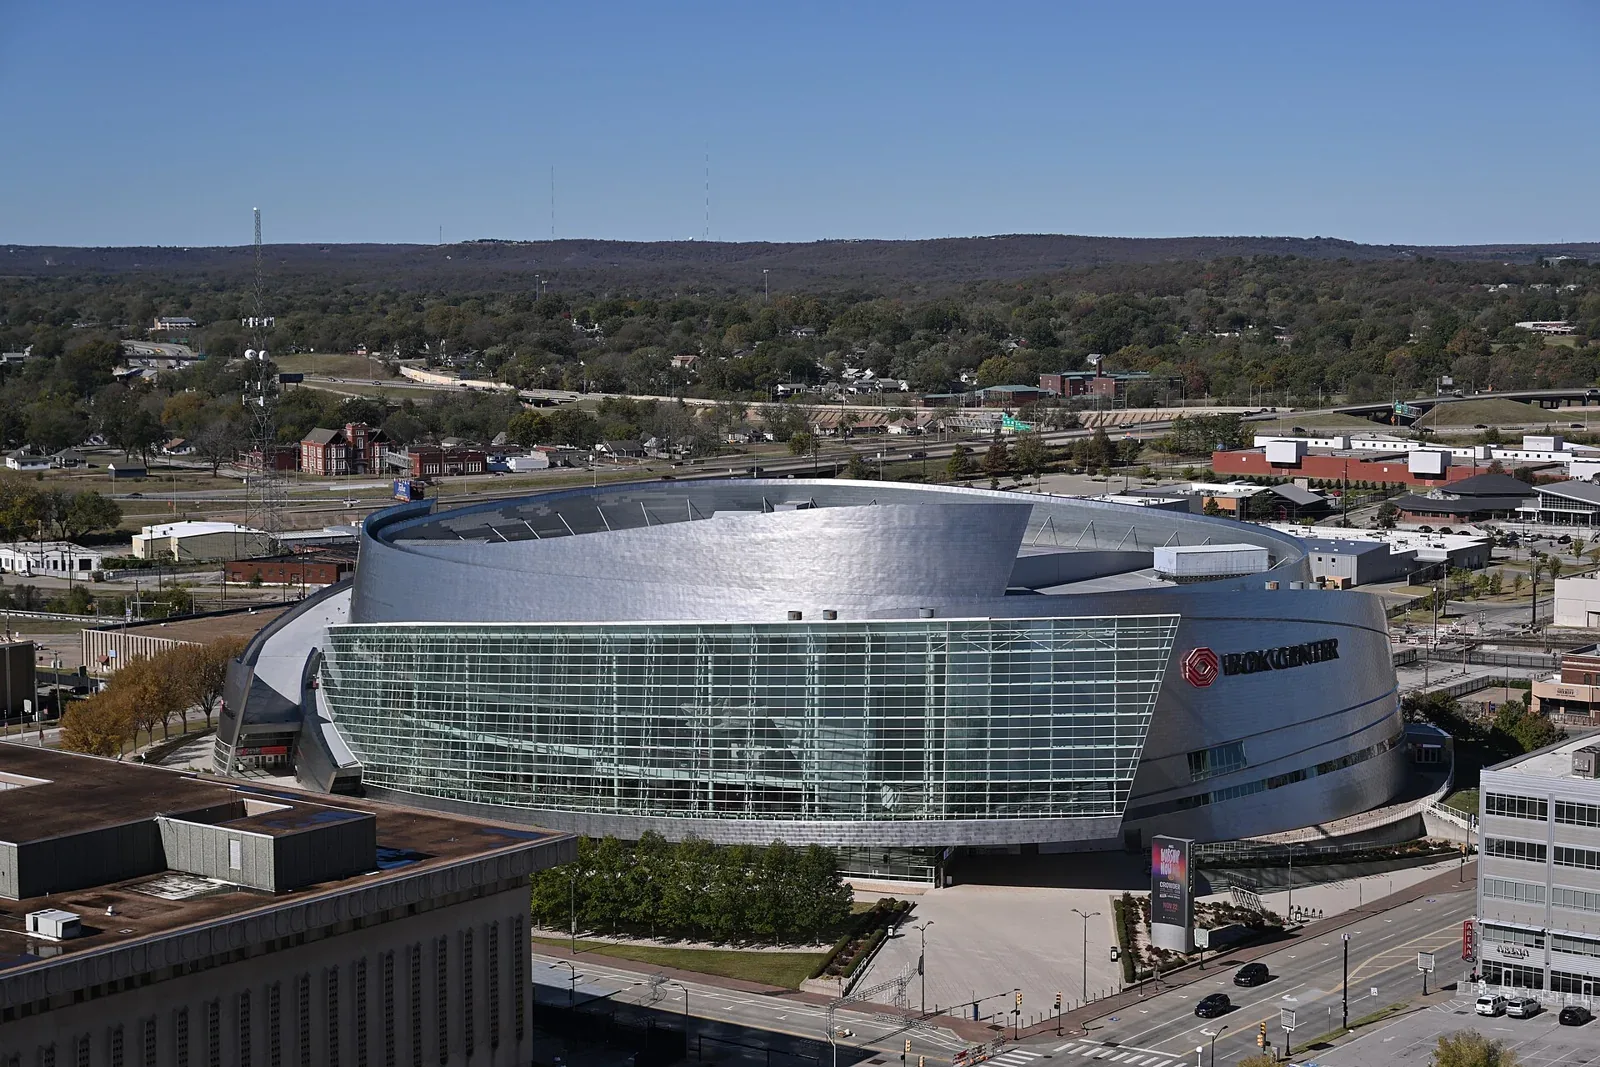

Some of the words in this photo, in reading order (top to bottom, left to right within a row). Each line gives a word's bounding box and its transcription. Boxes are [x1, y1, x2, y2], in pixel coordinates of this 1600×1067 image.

[1222, 650, 1272, 675] BOK
[1269, 638, 1339, 669] CENTER
[1497, 945, 1530, 957] ARENA
